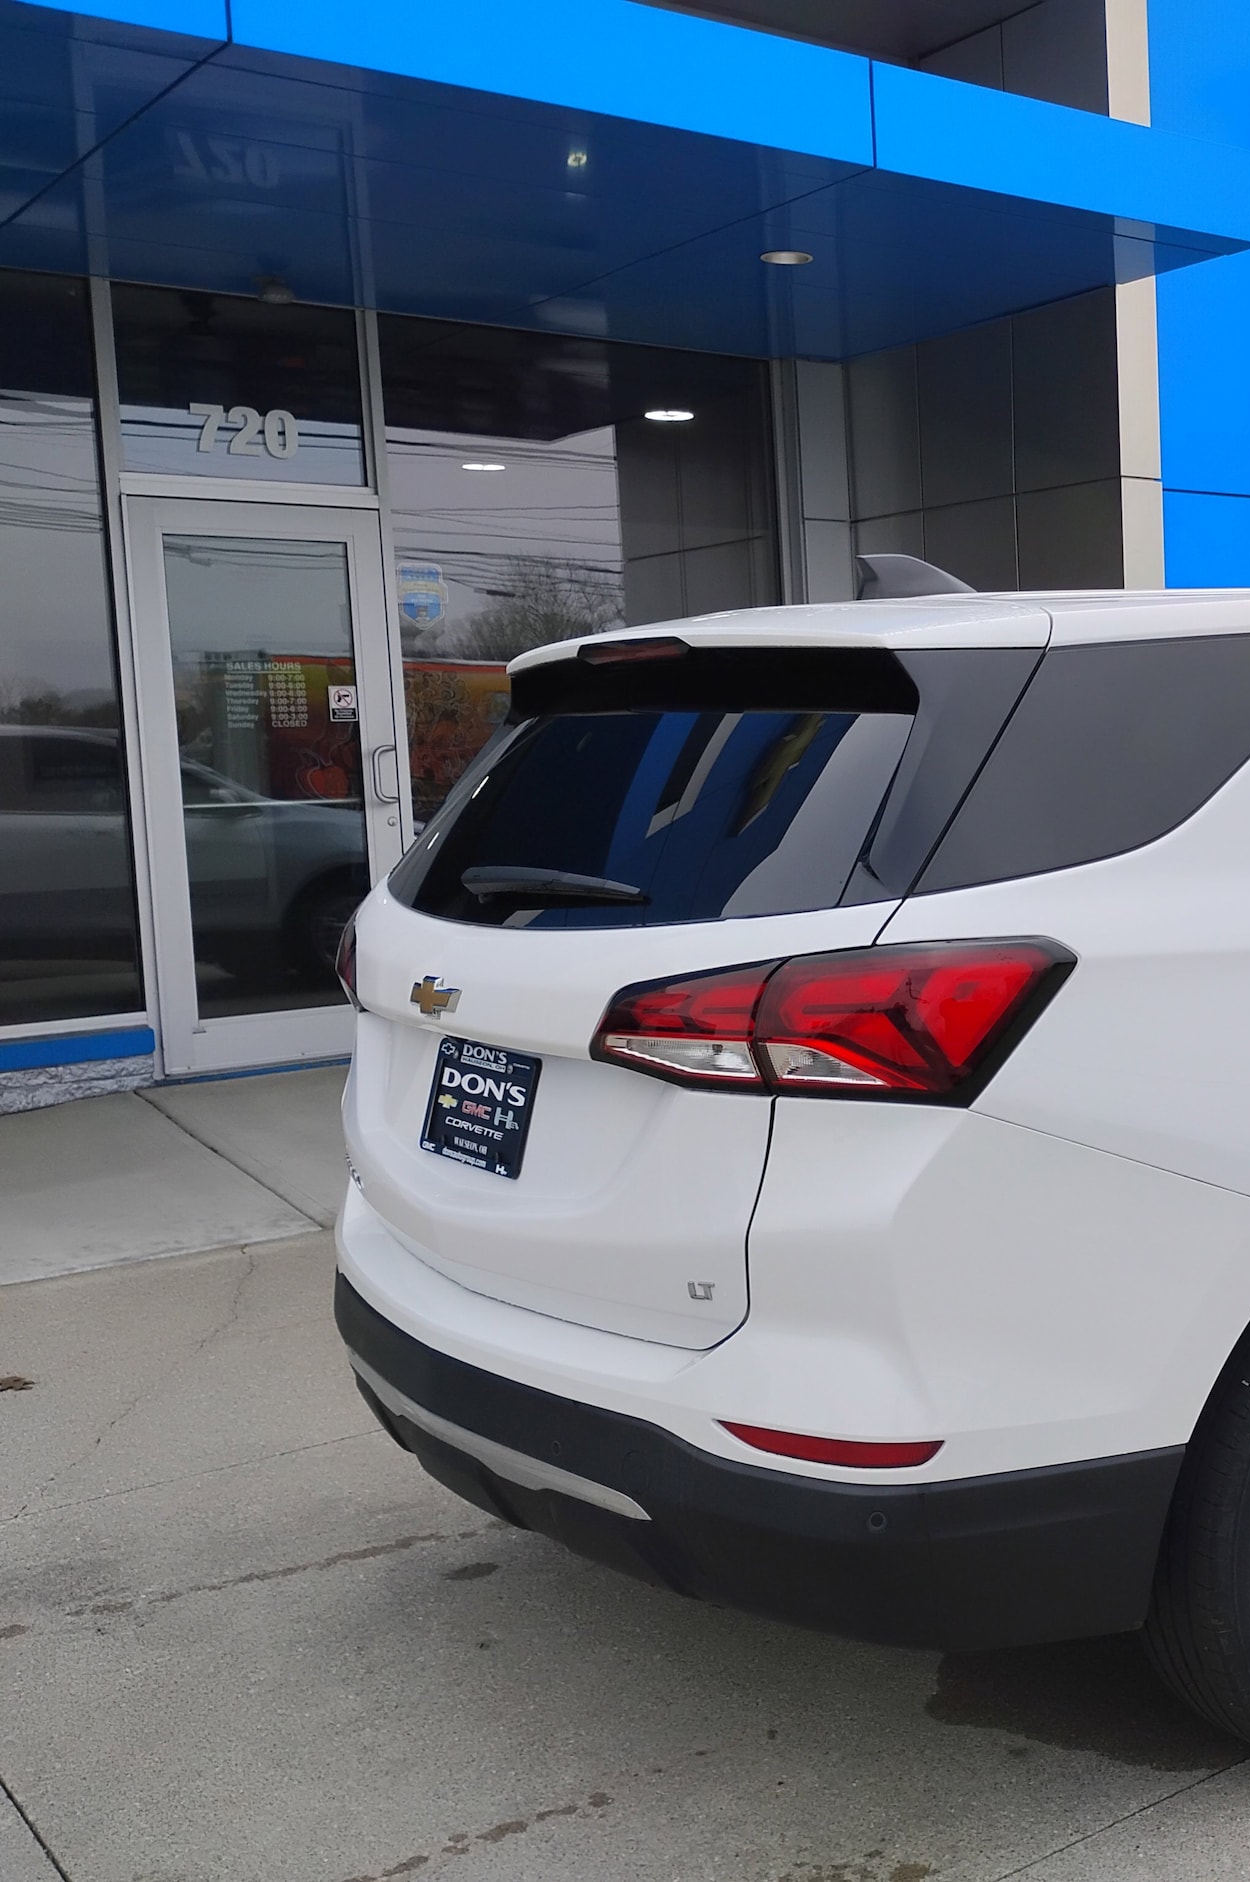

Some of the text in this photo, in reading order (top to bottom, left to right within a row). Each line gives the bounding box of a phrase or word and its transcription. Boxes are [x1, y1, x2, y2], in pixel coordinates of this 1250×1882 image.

[189, 402, 299, 460] 720
[226, 661, 302, 671] SALES HOURS
[224, 674, 253, 682] Monday
[225, 682, 254, 690] Tuesday
[272, 720, 308, 728] CLOSED
[462, 1043, 508, 1065] DON'S
[441, 1067, 526, 1107] DON'S
[462, 1100, 492, 1120] GMC
[445, 1116, 504, 1141] CORVETTE
[687, 1280, 716, 1301] LT
